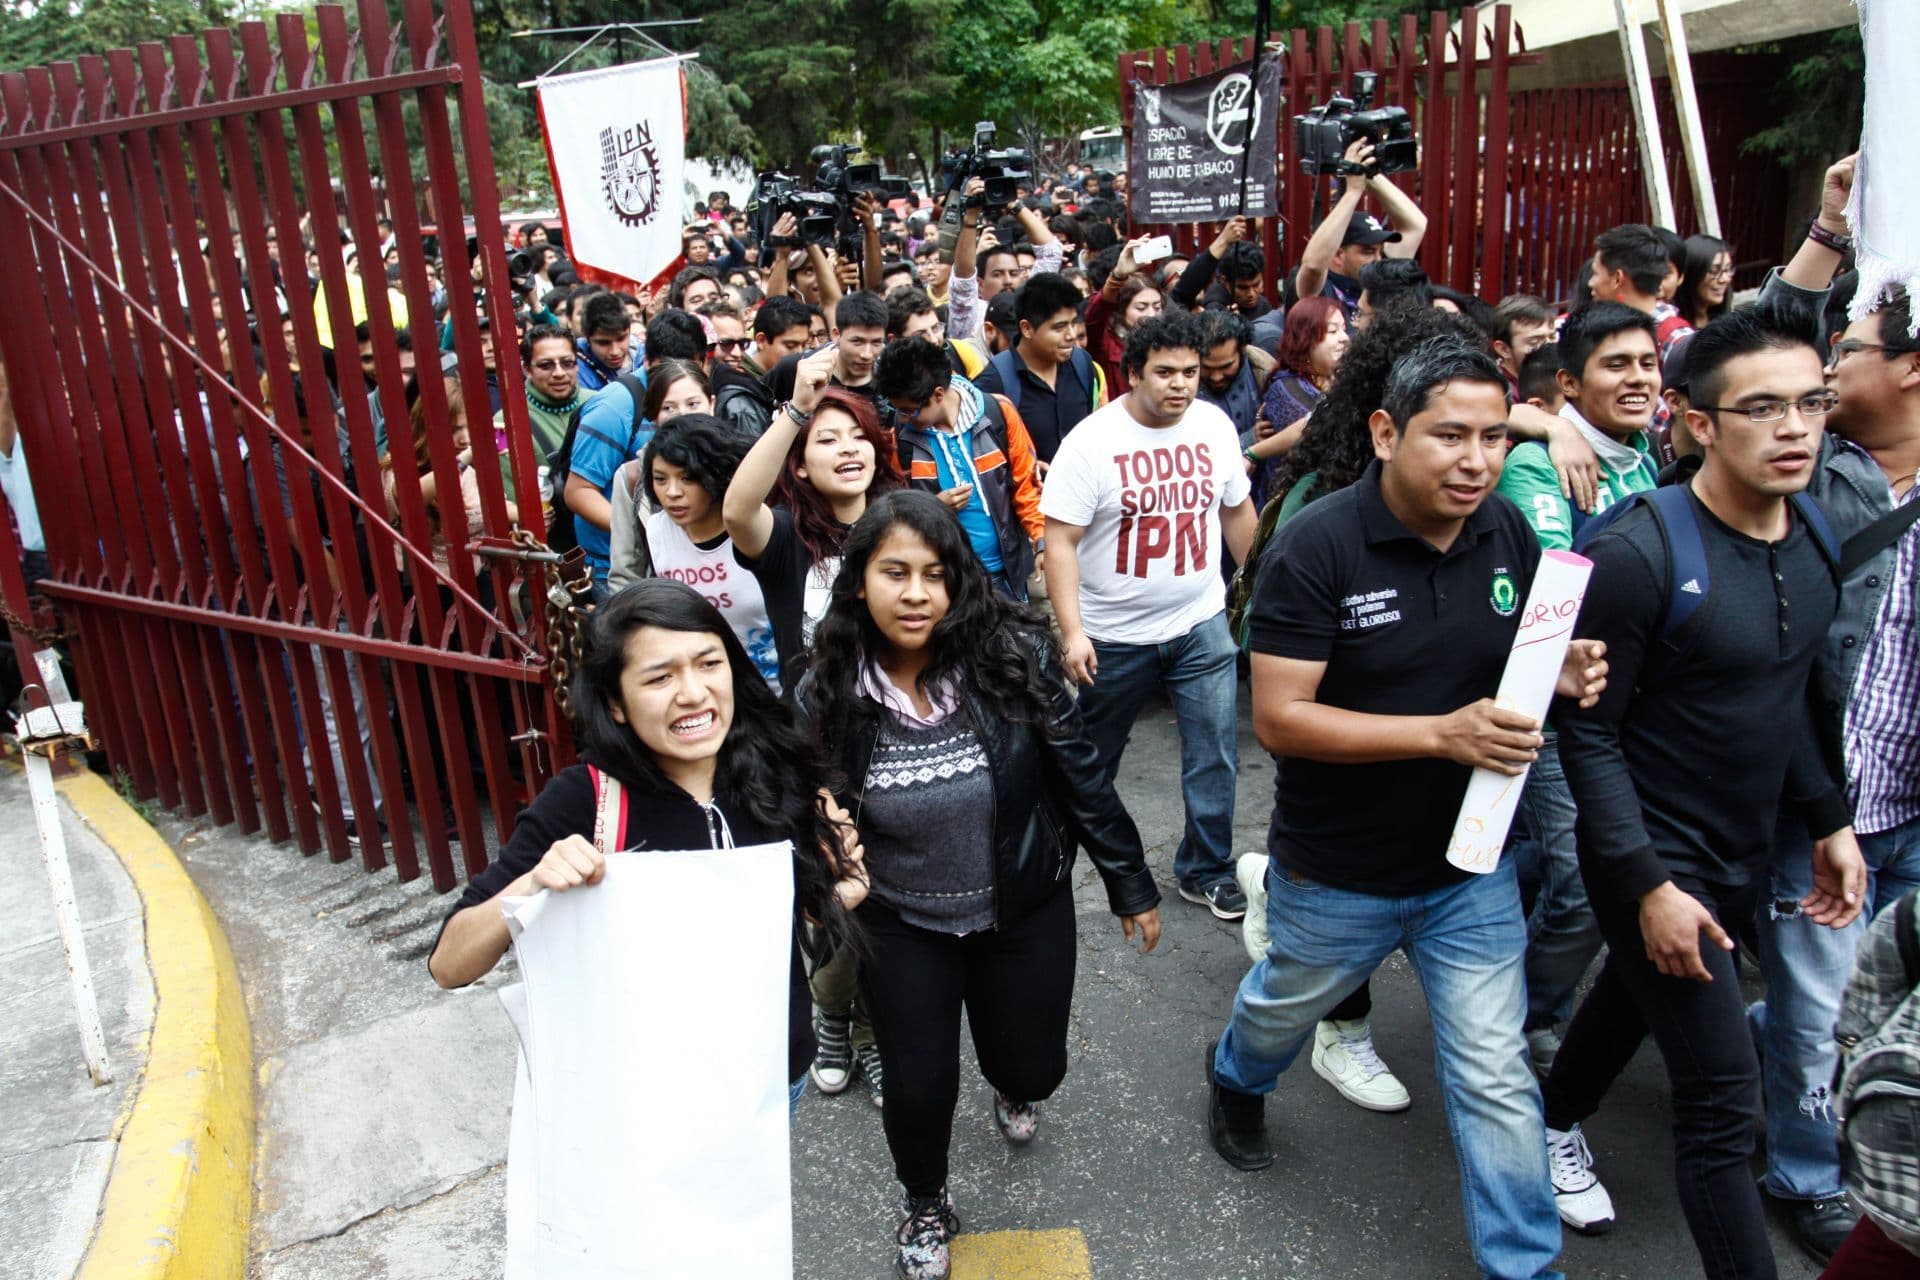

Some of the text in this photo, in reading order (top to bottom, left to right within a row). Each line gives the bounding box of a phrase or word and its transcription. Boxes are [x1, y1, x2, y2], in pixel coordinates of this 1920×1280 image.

[616, 118, 652, 157] IPN
[1177, 145, 1193, 160] DE
[1148, 165, 1175, 180] HUMO
[1176, 164, 1192, 178] DE
[1113, 442, 1213, 488] TODOS
[1120, 478, 1214, 517] SOMOS
[1533, 493, 1562, 531] 2
[1115, 511, 1208, 579] IPN
